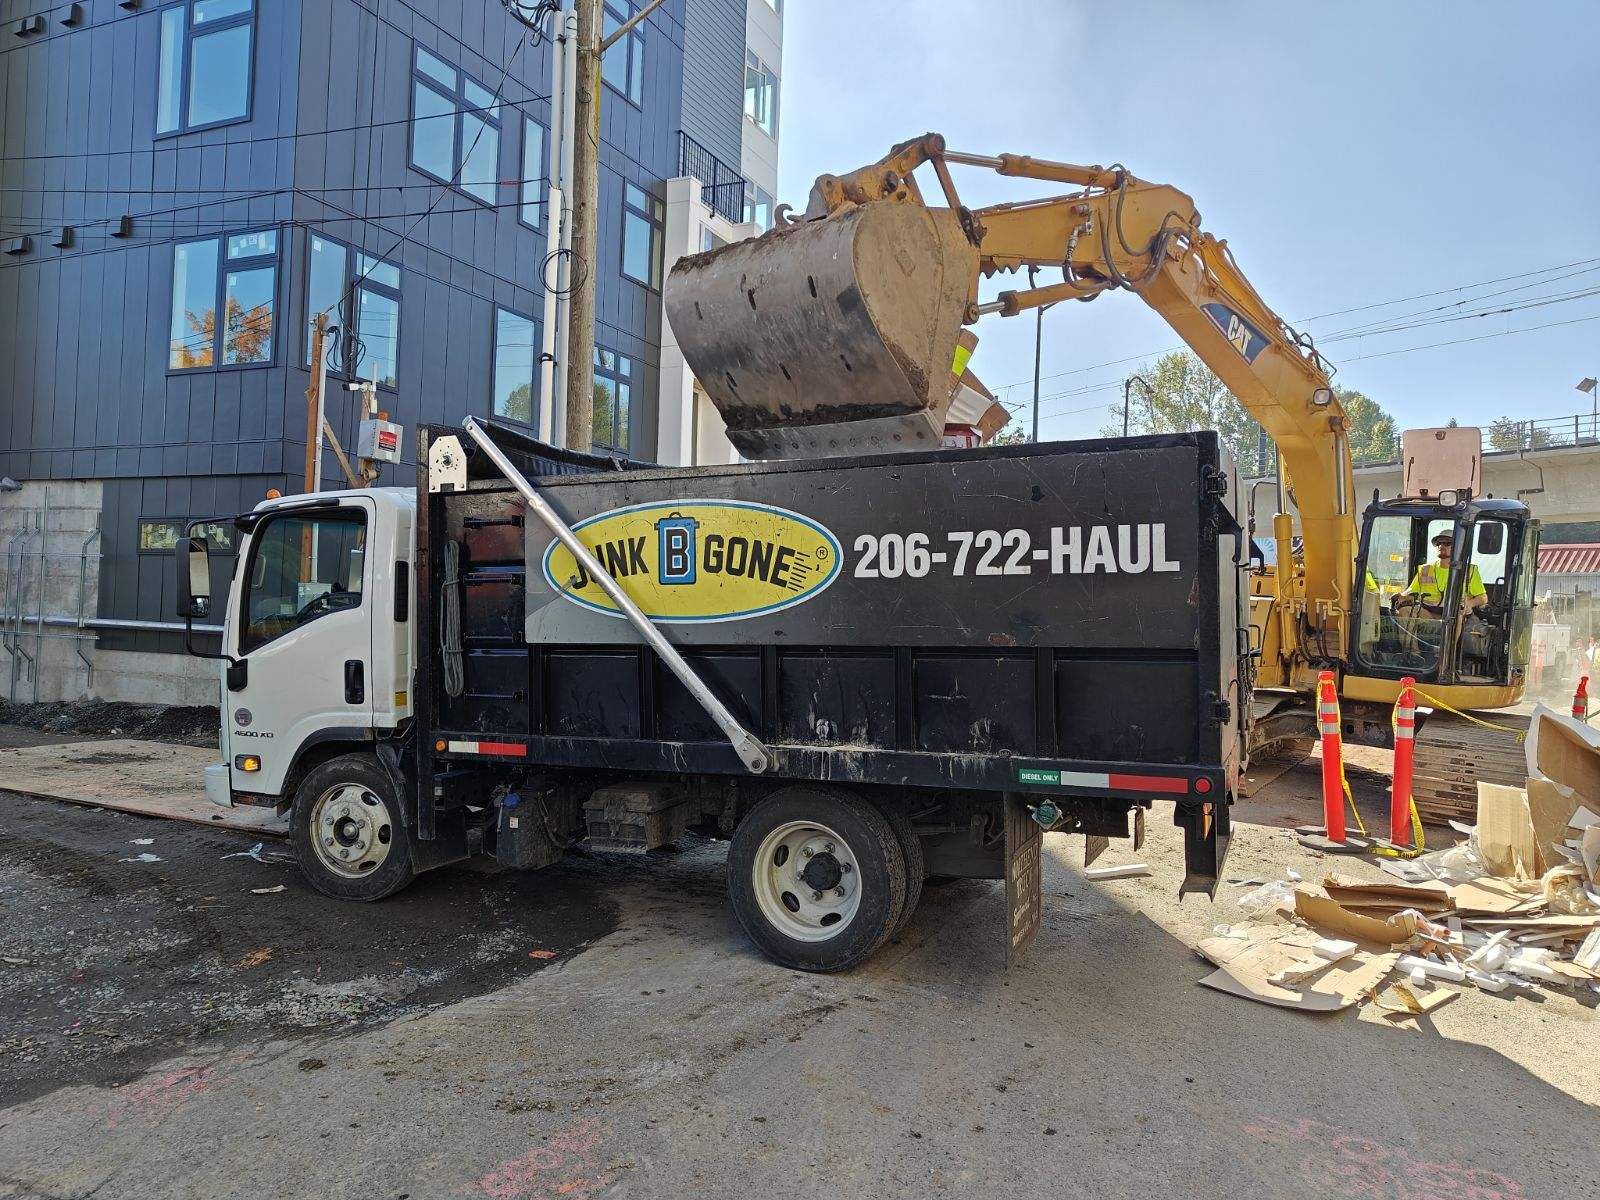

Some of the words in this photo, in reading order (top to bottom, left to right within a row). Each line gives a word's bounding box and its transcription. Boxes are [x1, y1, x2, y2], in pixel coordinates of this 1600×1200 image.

[1227, 314, 1252, 356] CAT
[664, 527, 691, 578] B
[703, 534, 796, 588] GONE
[853, 523, 1181, 579] 206-722-HAUL
[233, 730, 259, 738] 4500
[1021, 773, 1042, 781] DIESEL
[1042, 774, 1059, 782] ONLY
